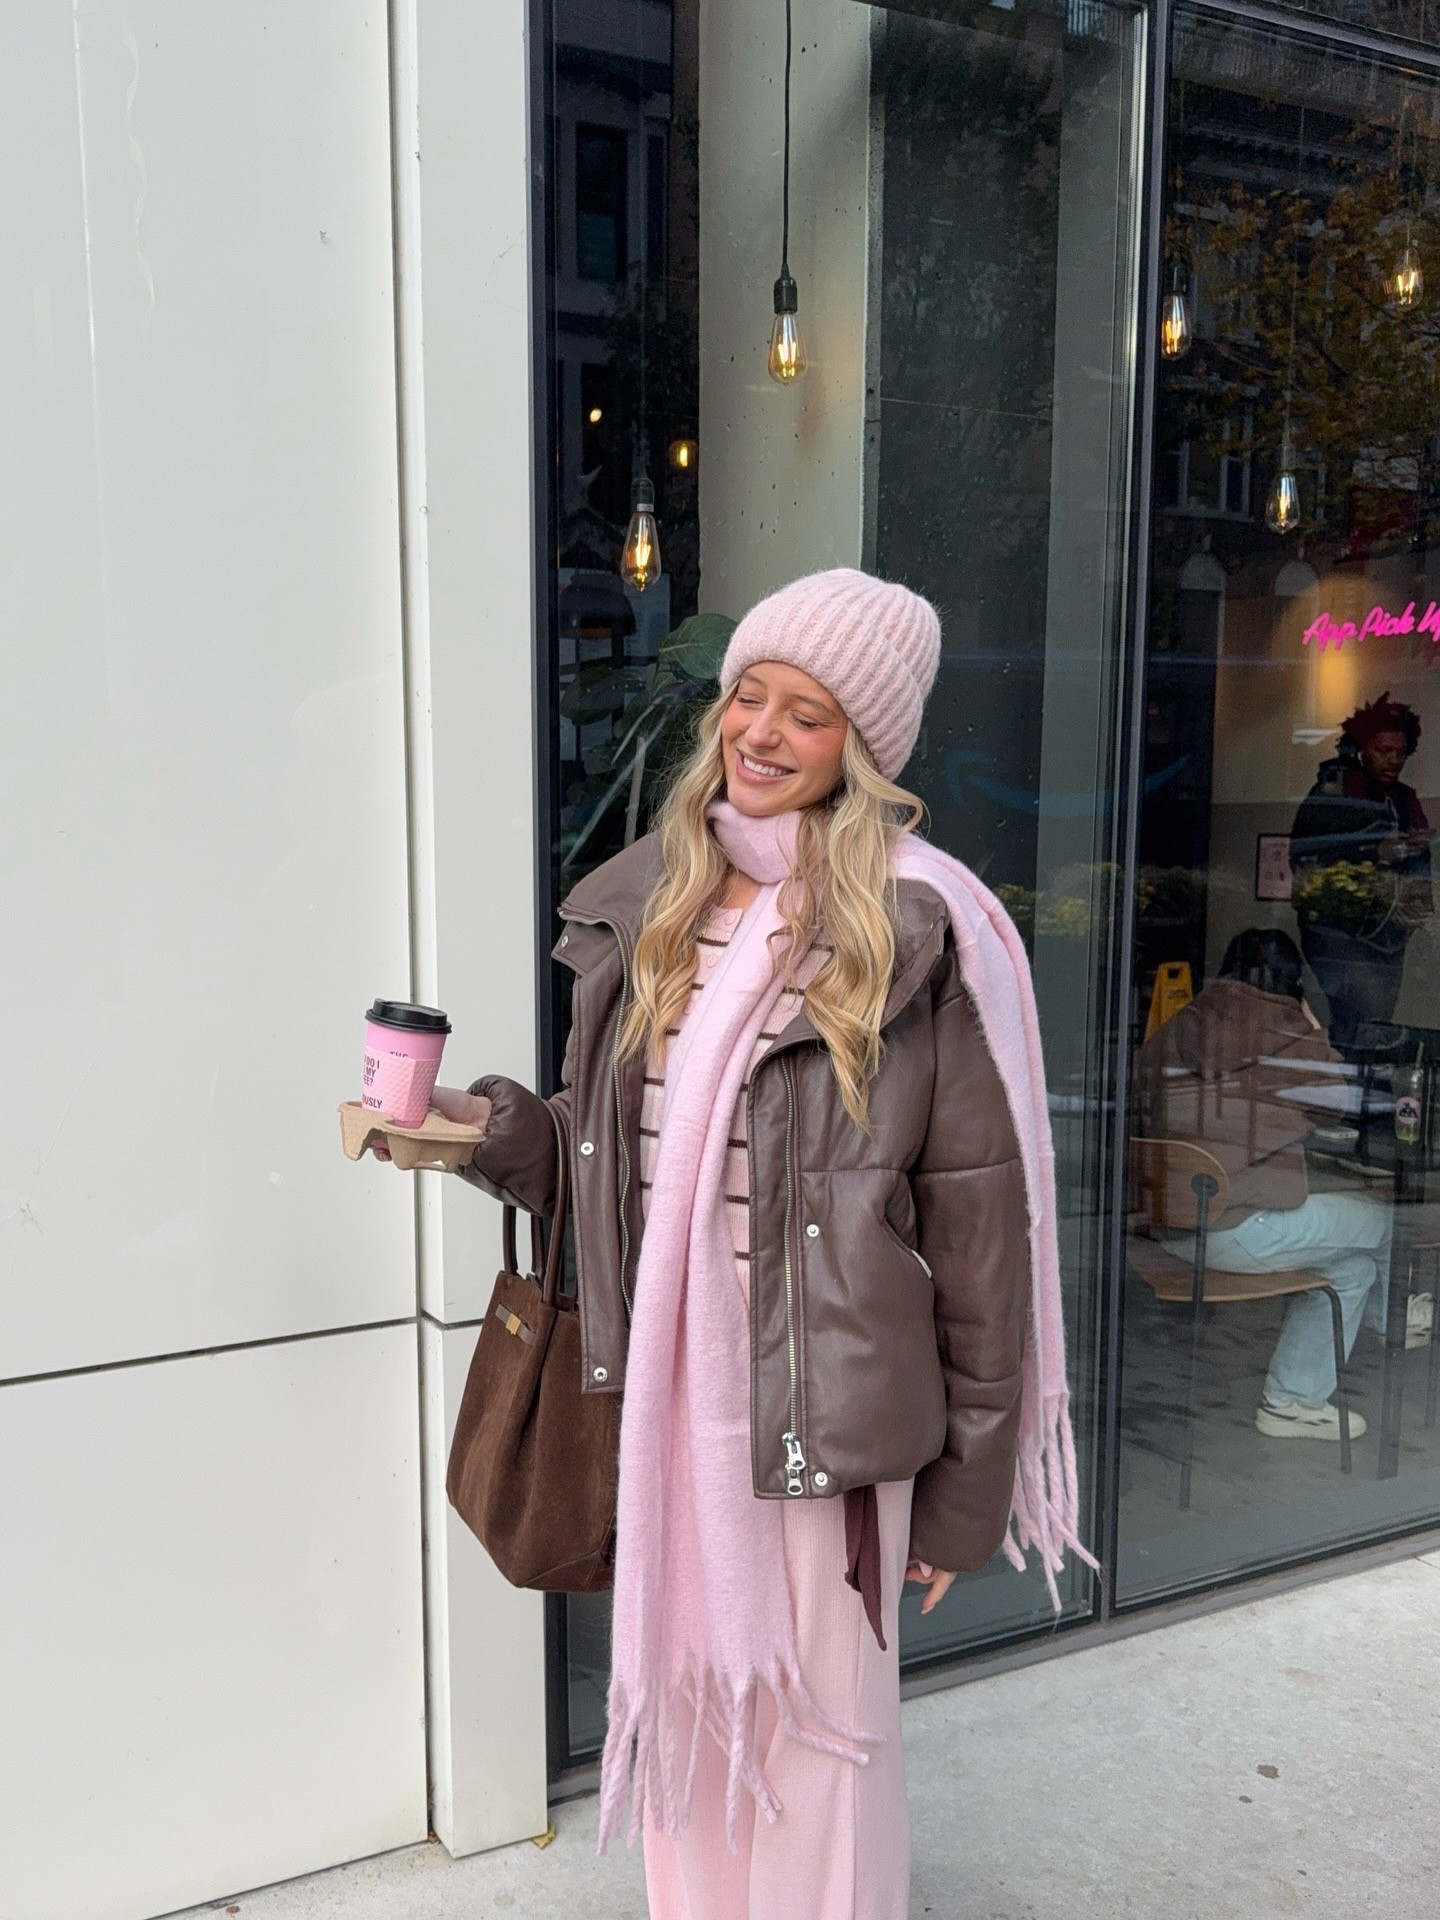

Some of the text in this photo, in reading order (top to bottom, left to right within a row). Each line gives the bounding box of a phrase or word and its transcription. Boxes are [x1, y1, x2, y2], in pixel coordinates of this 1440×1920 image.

[1302, 612, 1358, 653] App
[1358, 601, 1416, 642] Pick
[366, 1056, 375, 1068] DO
[366, 1066, 376, 1077] MY
